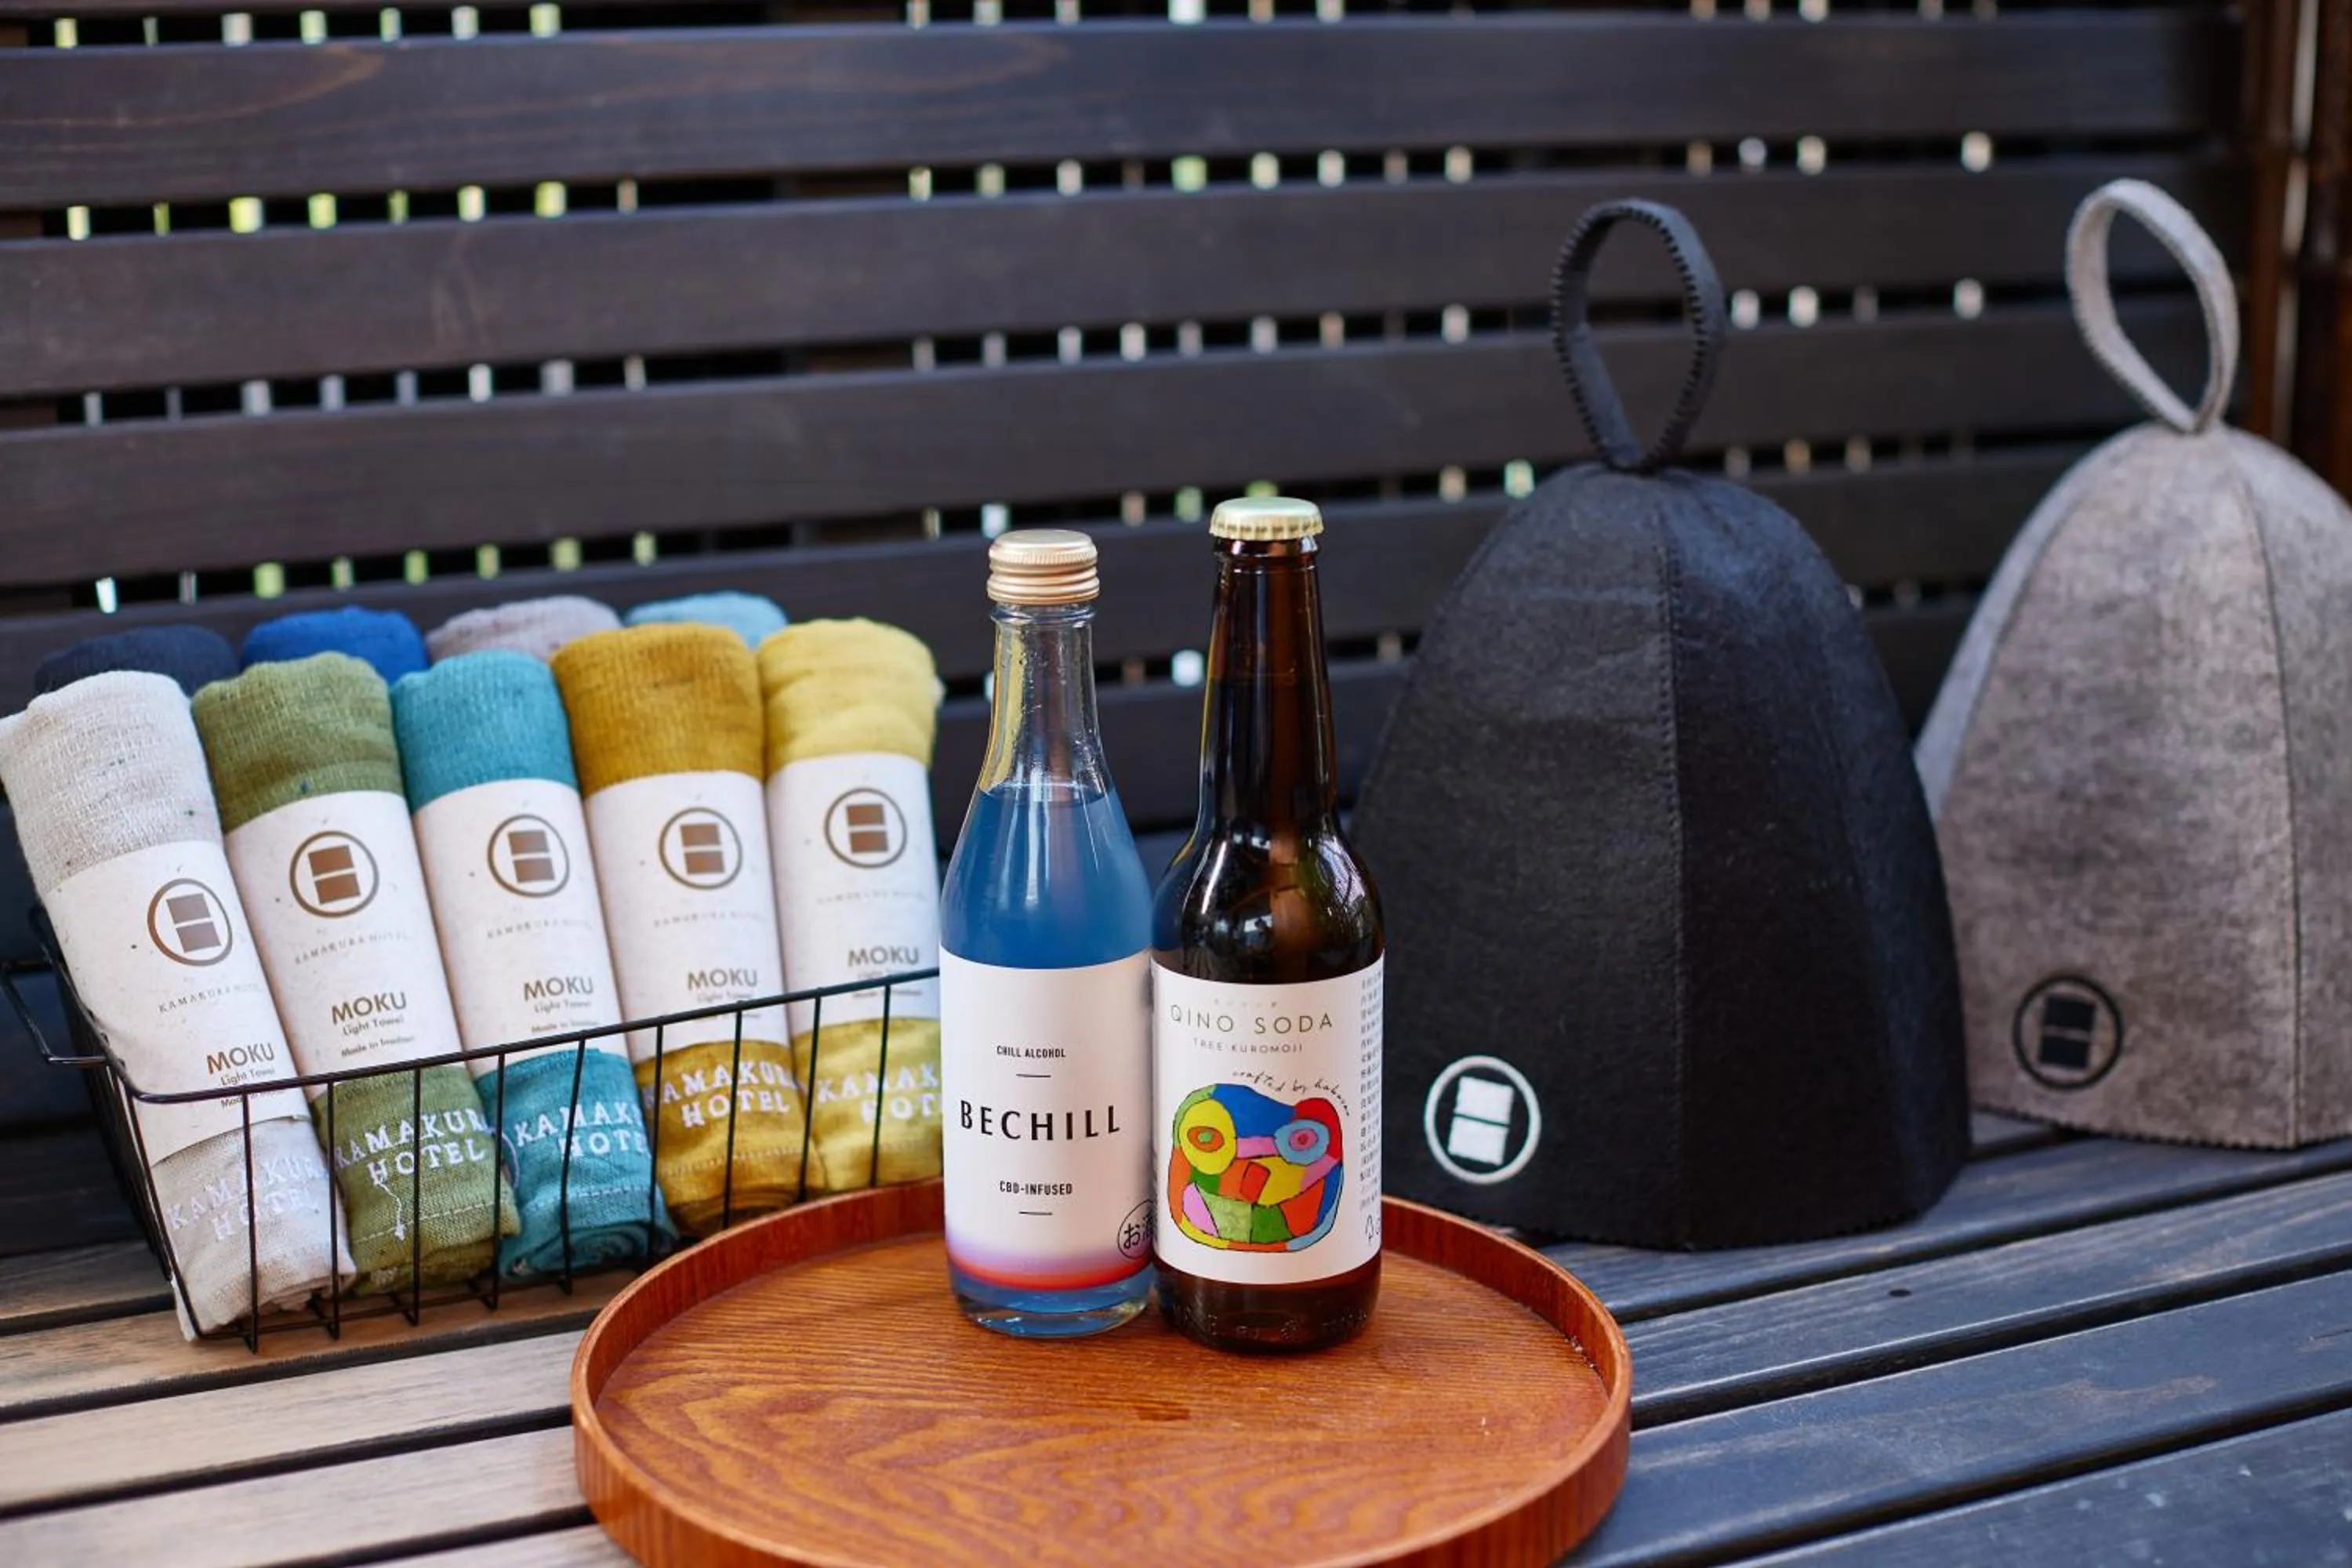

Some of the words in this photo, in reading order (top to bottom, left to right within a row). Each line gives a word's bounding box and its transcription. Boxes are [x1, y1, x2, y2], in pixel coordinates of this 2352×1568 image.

[848, 946, 919, 967] MOKU
[524, 977, 593, 1002] MOKU
[688, 967, 758, 991] MOKU
[332, 991, 407, 1025] MOKU
[1171, 1004, 1234, 1033] QINO
[1254, 1012, 1333, 1034] SODA
[343, 1022, 370, 1036] Light
[206, 1043, 275, 1075] MOKU
[996, 1045, 1021, 1058] CHILL
[1025, 1047, 1066, 1058] ALCOHOL
[1192, 1037, 1223, 1051] TREE
[1231, 1043, 1304, 1054] KUROMOJI
[220, 1073, 248, 1086] Light
[220, 1097, 243, 1110] Mad
[681, 1078, 790, 1127] HOTEL
[861, 1093, 941, 1124] HOT
[960, 1100, 1120, 1141] BECHILL
[558, 1129, 652, 1163] HOTE
[368, 1138, 485, 1186] HOTEL
[1000, 1181, 1073, 1196] CBD-INFUSED
[211, 1187, 319, 1241] HOTEL
